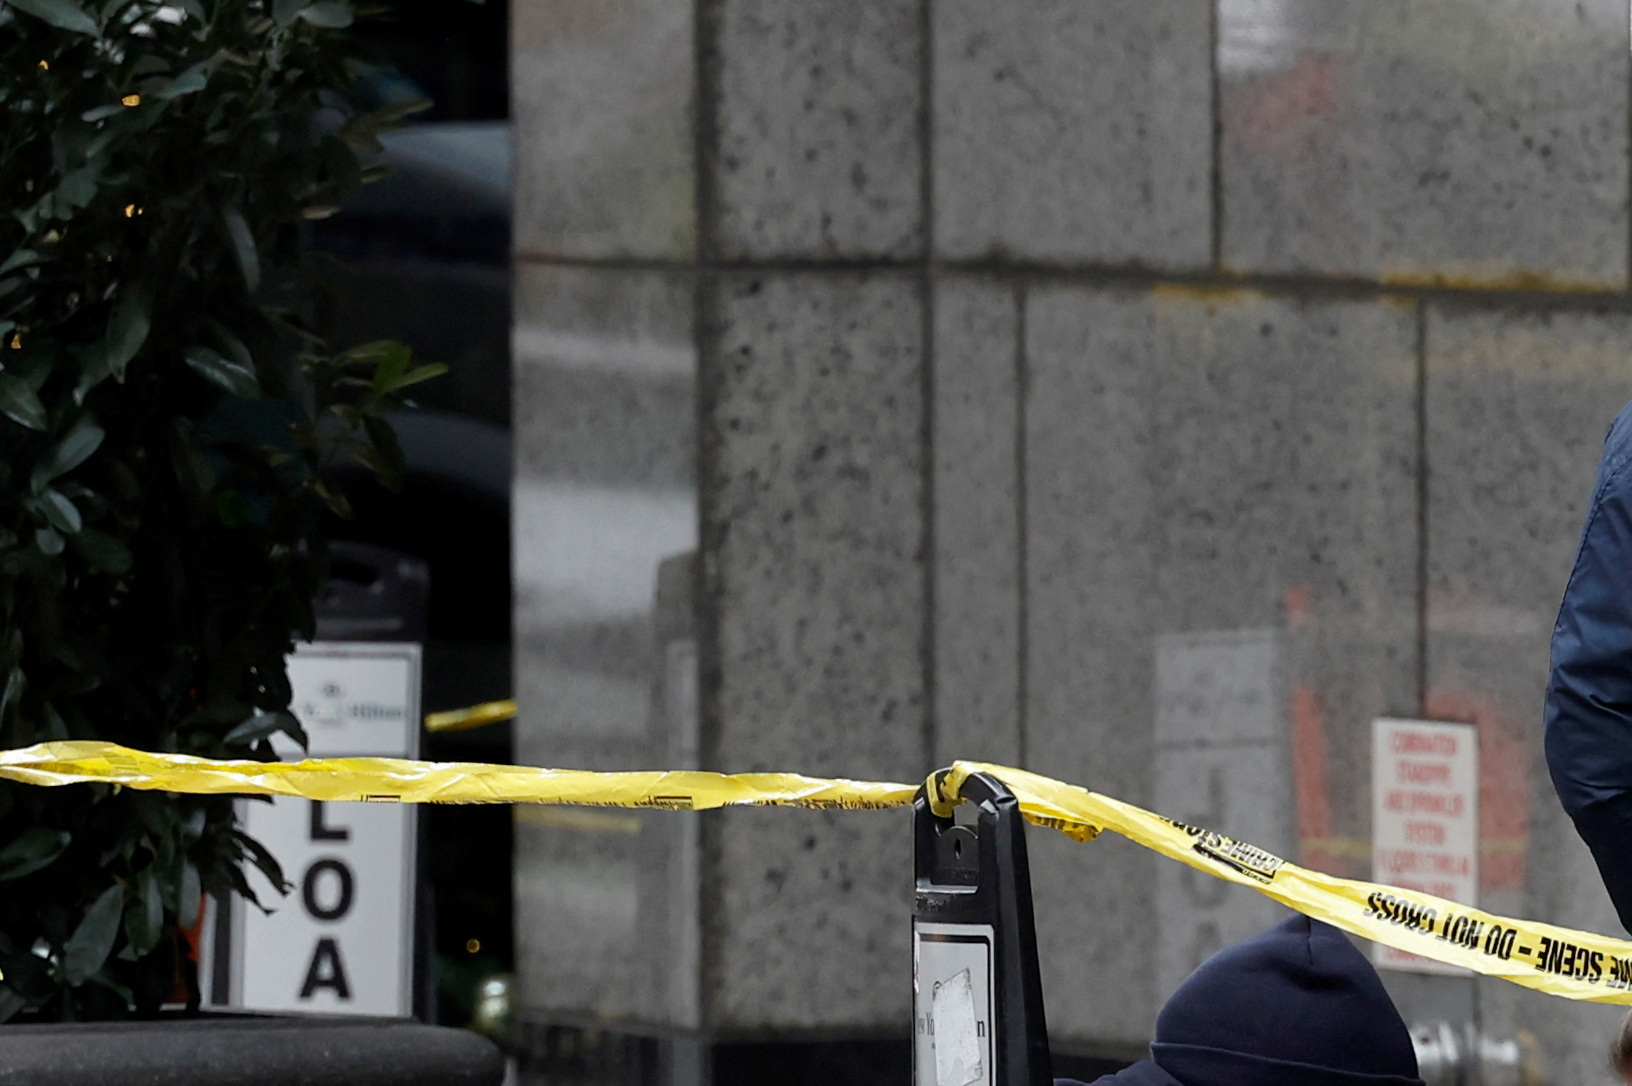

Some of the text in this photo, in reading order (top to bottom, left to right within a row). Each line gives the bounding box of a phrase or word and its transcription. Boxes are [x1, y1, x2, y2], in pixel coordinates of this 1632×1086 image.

[1362, 891, 1438, 936] CROSS
[1437, 912, 1485, 950] NOT
[1484, 924, 1517, 961] DO
[1535, 937, 1604, 984] SCENE
